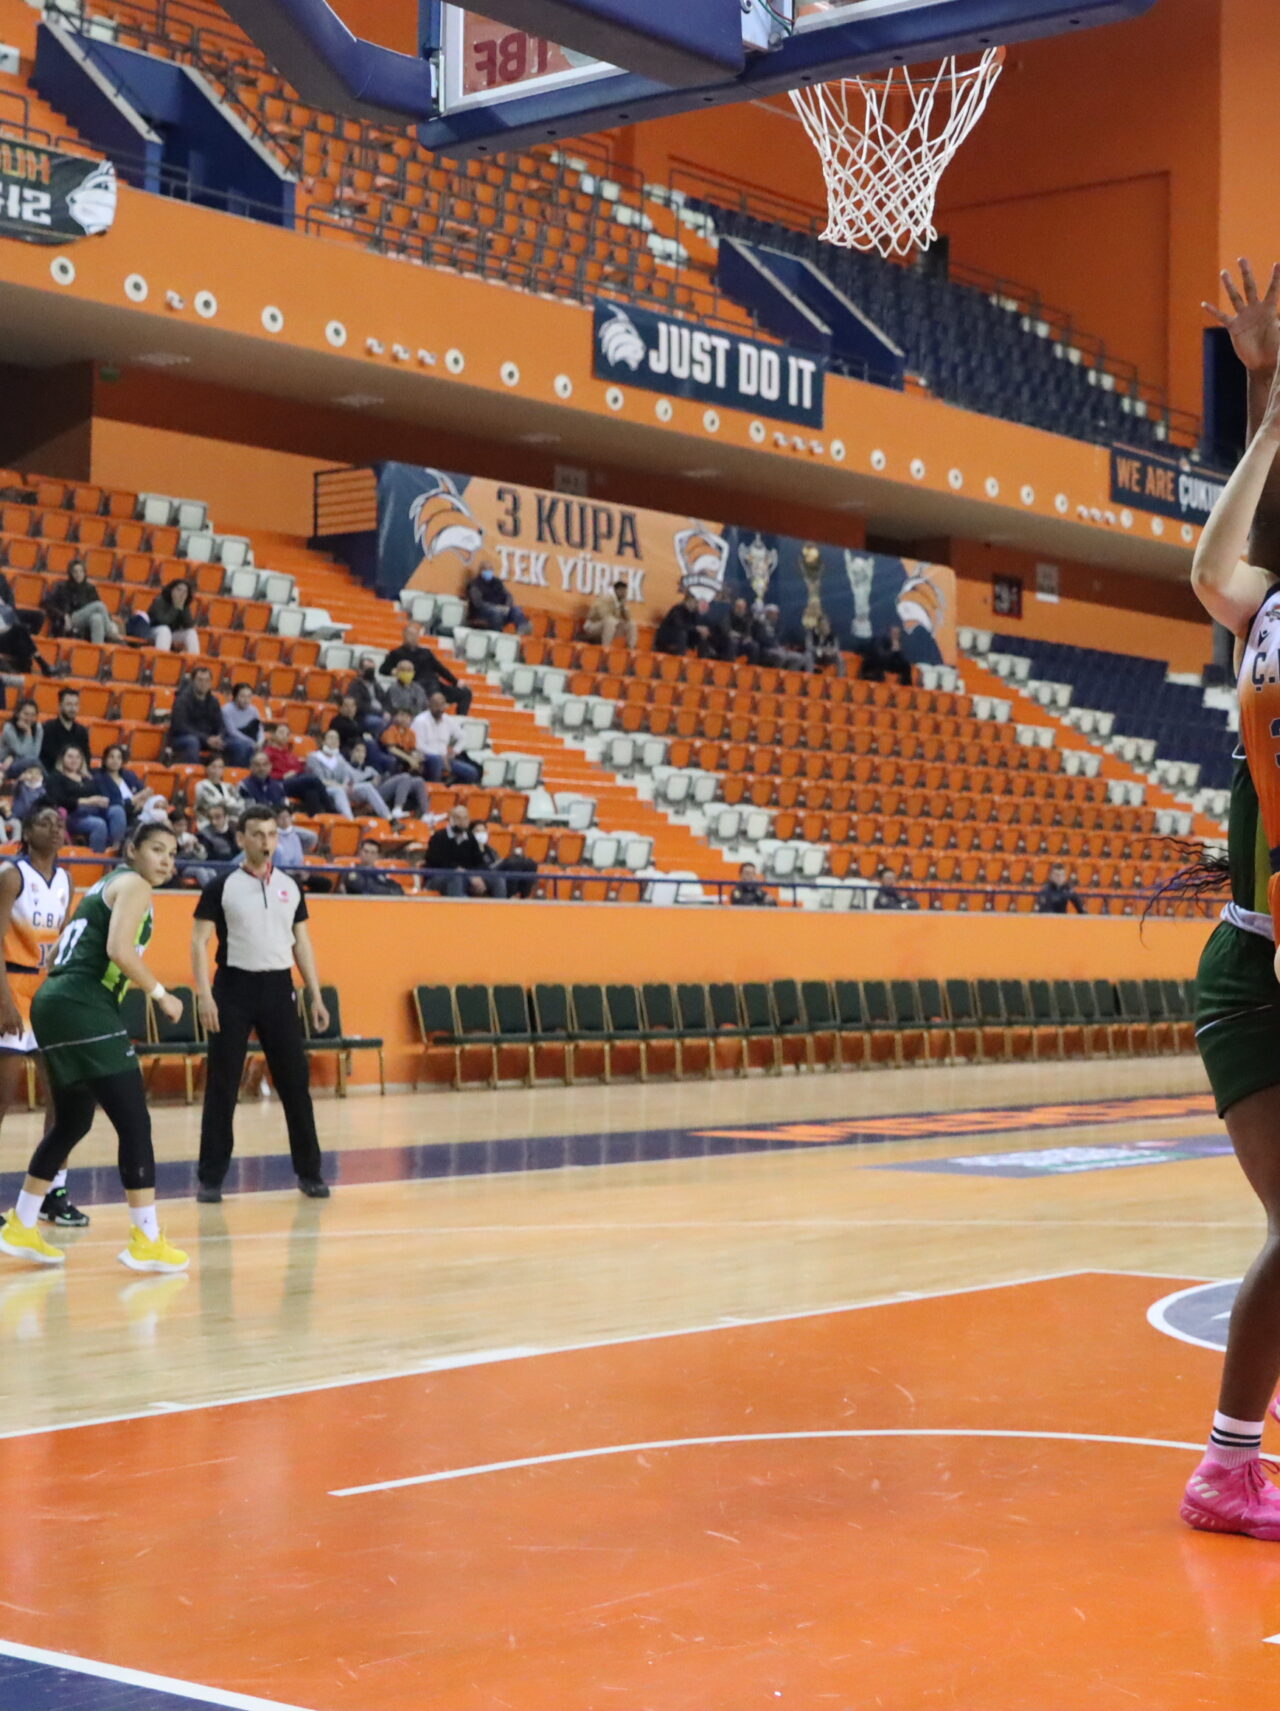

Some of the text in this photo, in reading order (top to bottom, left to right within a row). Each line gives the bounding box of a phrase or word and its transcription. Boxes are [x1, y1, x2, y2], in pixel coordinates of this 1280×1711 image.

[648, 321, 816, 410] JUST DO IT
[1116, 456, 1142, 493] WE
[1145, 465, 1176, 502] ARE
[496, 486, 643, 560] 3 KUPA
[495, 545, 550, 587] TEK
